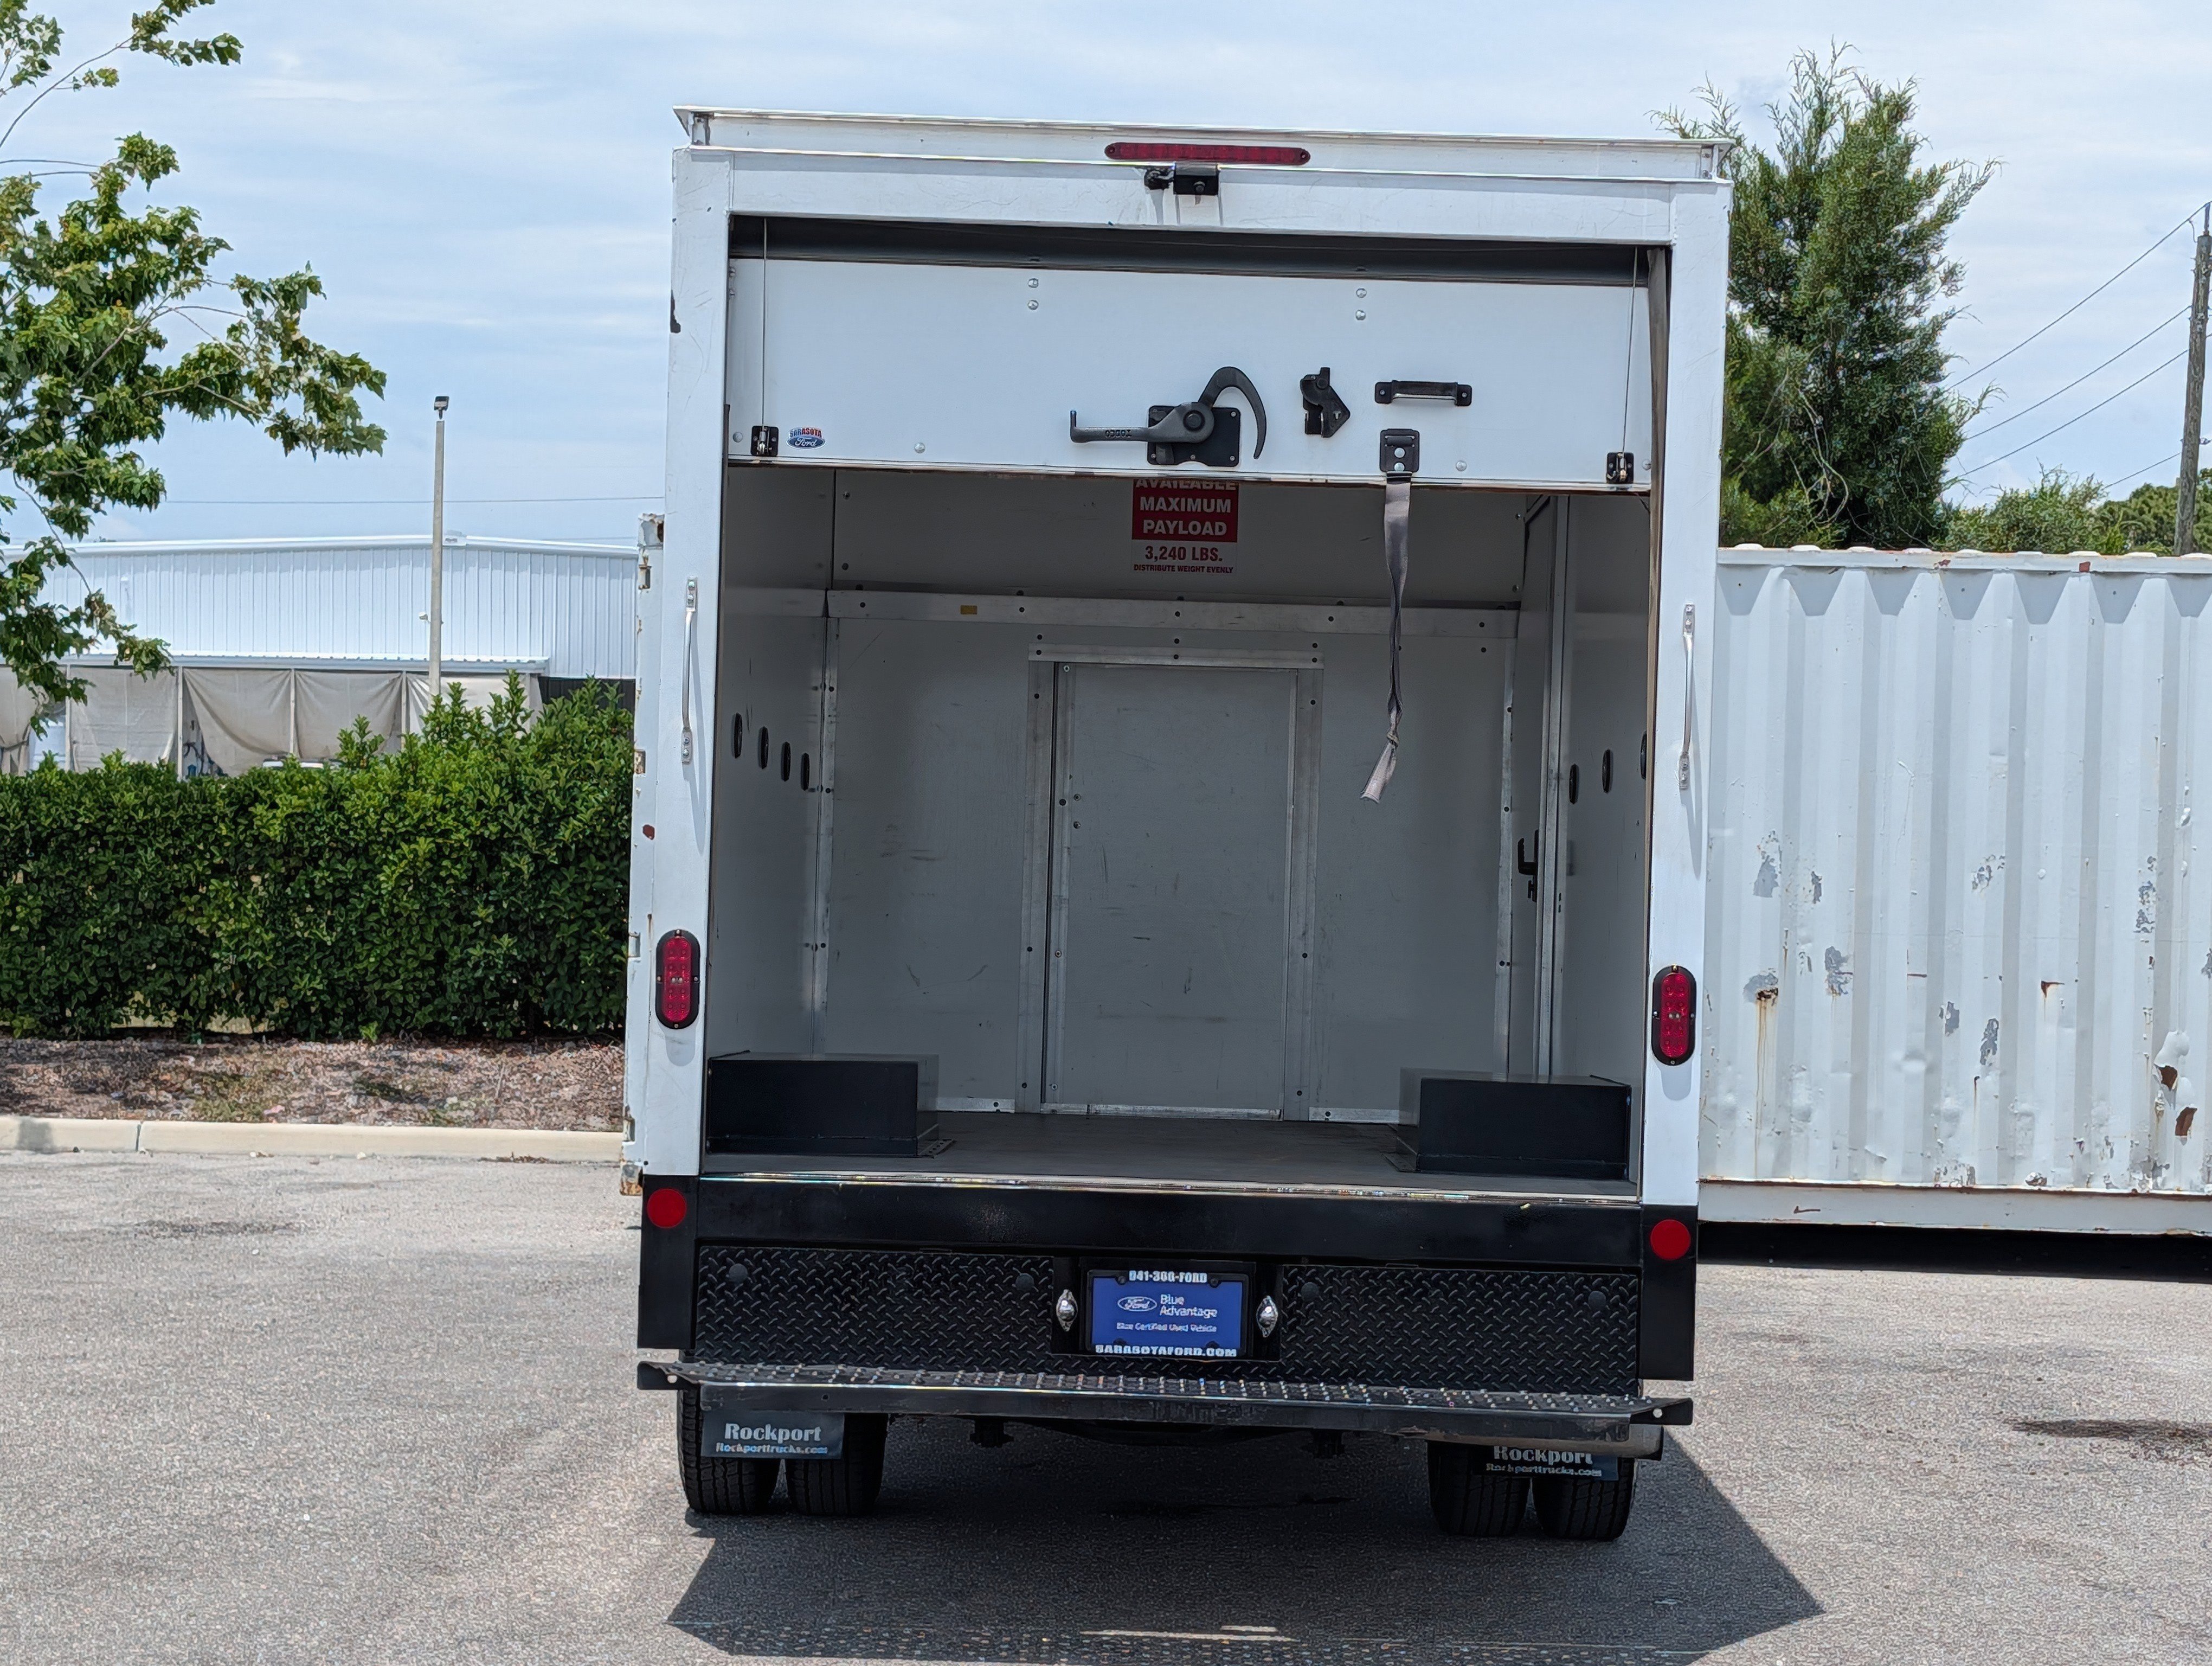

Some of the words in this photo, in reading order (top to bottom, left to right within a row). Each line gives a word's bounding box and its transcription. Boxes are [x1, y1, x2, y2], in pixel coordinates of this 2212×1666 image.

[789, 428, 822, 437] SARASOTA
[795, 437, 817, 447] Ford
[1140, 497, 1231, 513] MAXIMUM
[1143, 520, 1227, 536] PAYLOAD
[1145, 546, 1186, 562] 3,240
[1192, 547, 1223, 562] LBS.
[1134, 564, 1175, 572] DISTRIBUTE
[1206, 566, 1233, 574] EVENLY
[1160, 1294, 1185, 1305] Blue
[1159, 1305, 1218, 1318] Advantage
[724, 1423, 821, 1444] Rockport
[1494, 1445, 1593, 1465] Rockport
